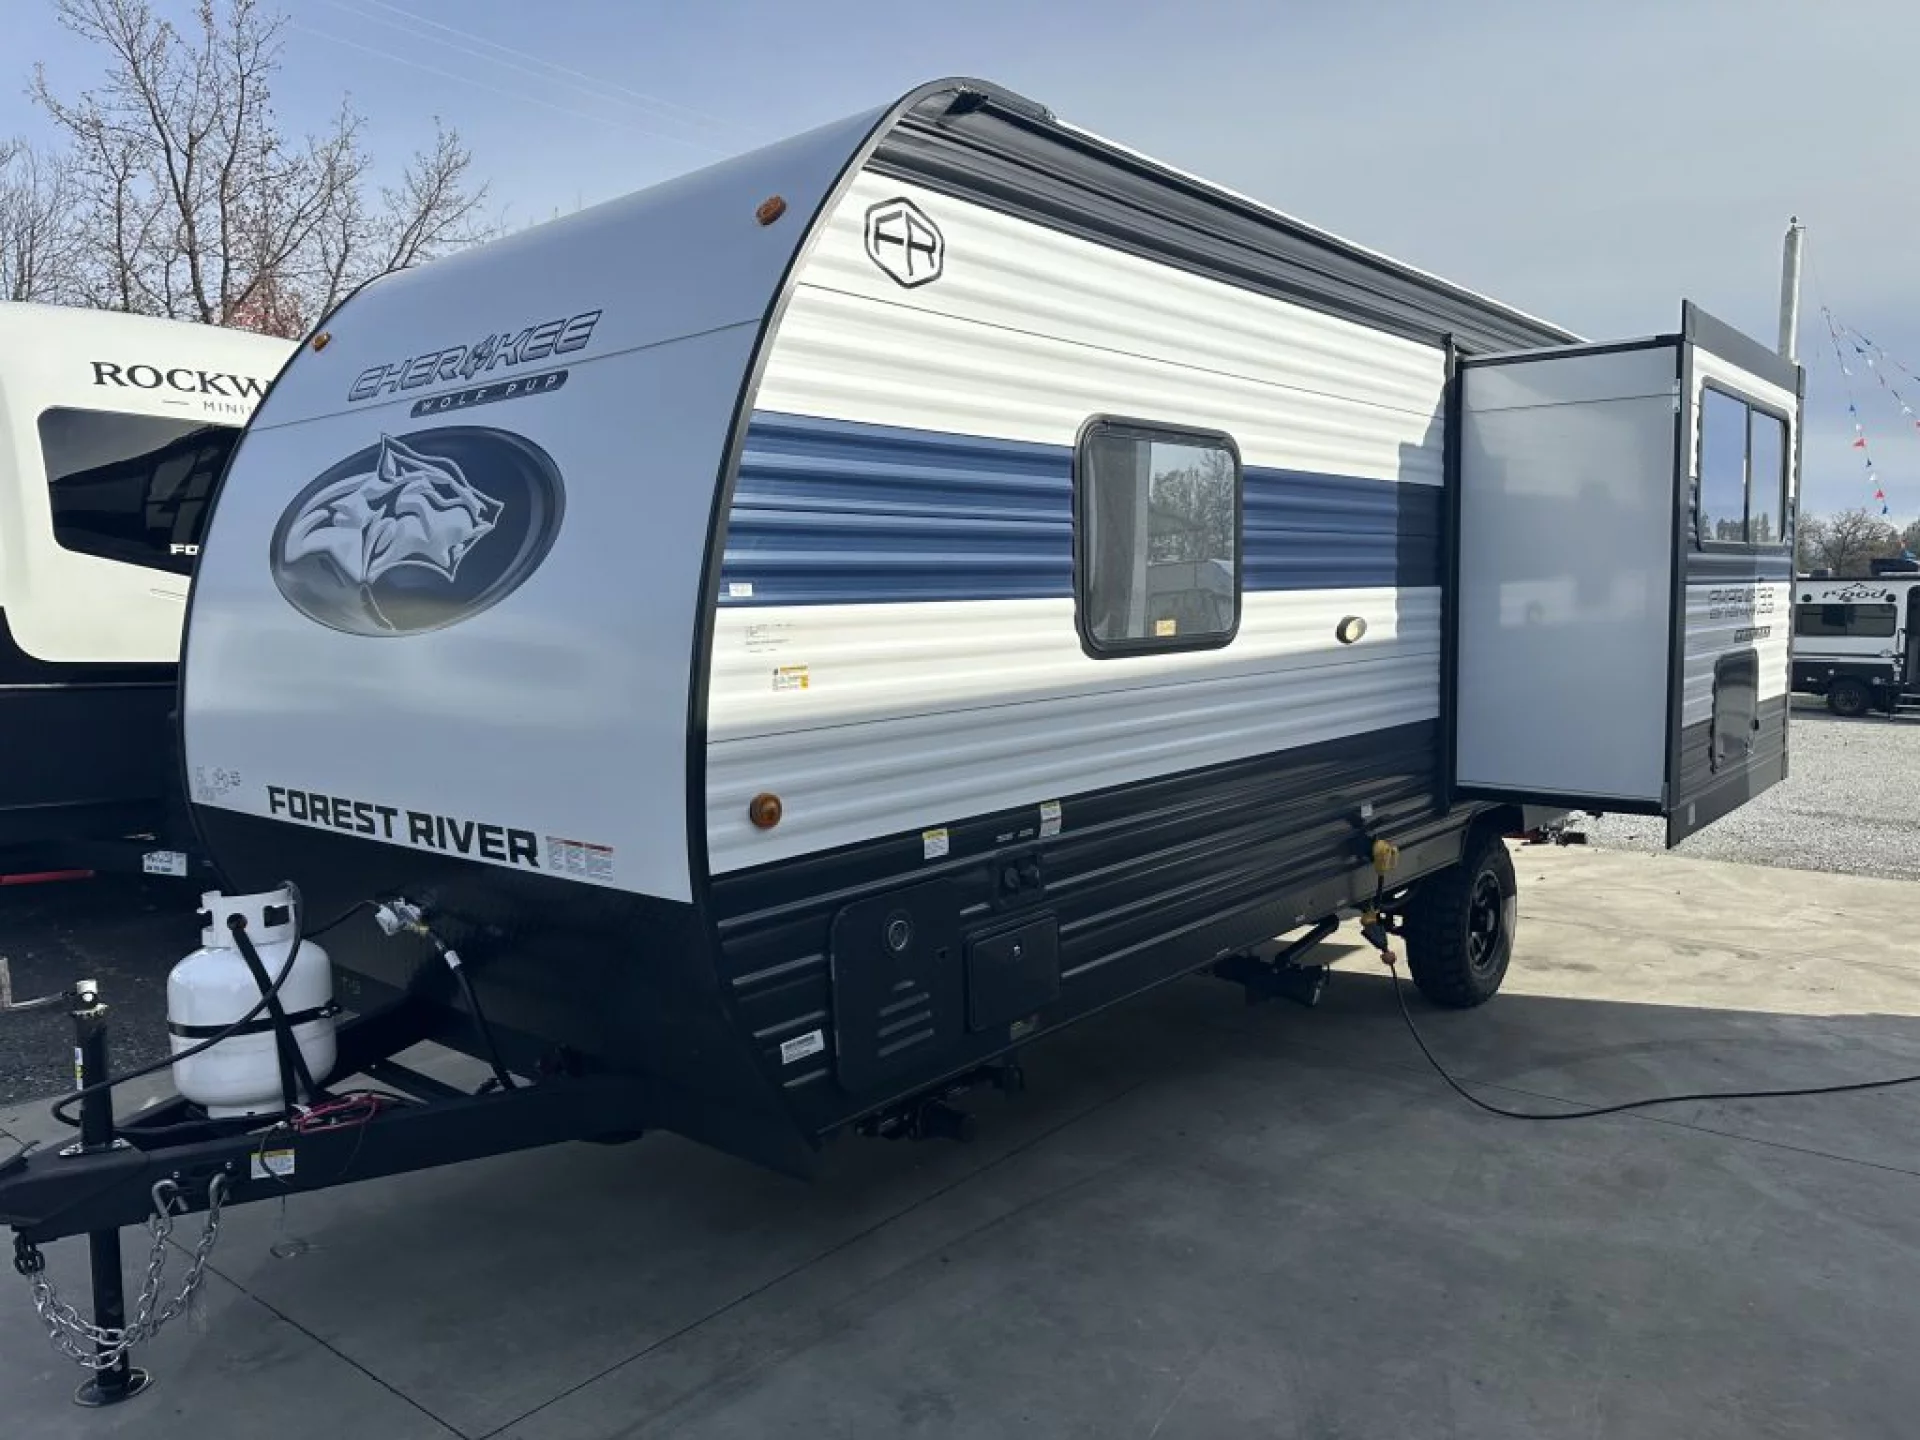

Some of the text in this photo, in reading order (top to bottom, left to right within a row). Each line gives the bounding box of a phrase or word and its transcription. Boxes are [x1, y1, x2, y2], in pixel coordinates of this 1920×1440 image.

[90, 361, 273, 399] ROCKW
[421, 373, 558, 412] WOLF PUP
[267, 785, 398, 838] FOREST
[406, 809, 539, 868] RIVER
